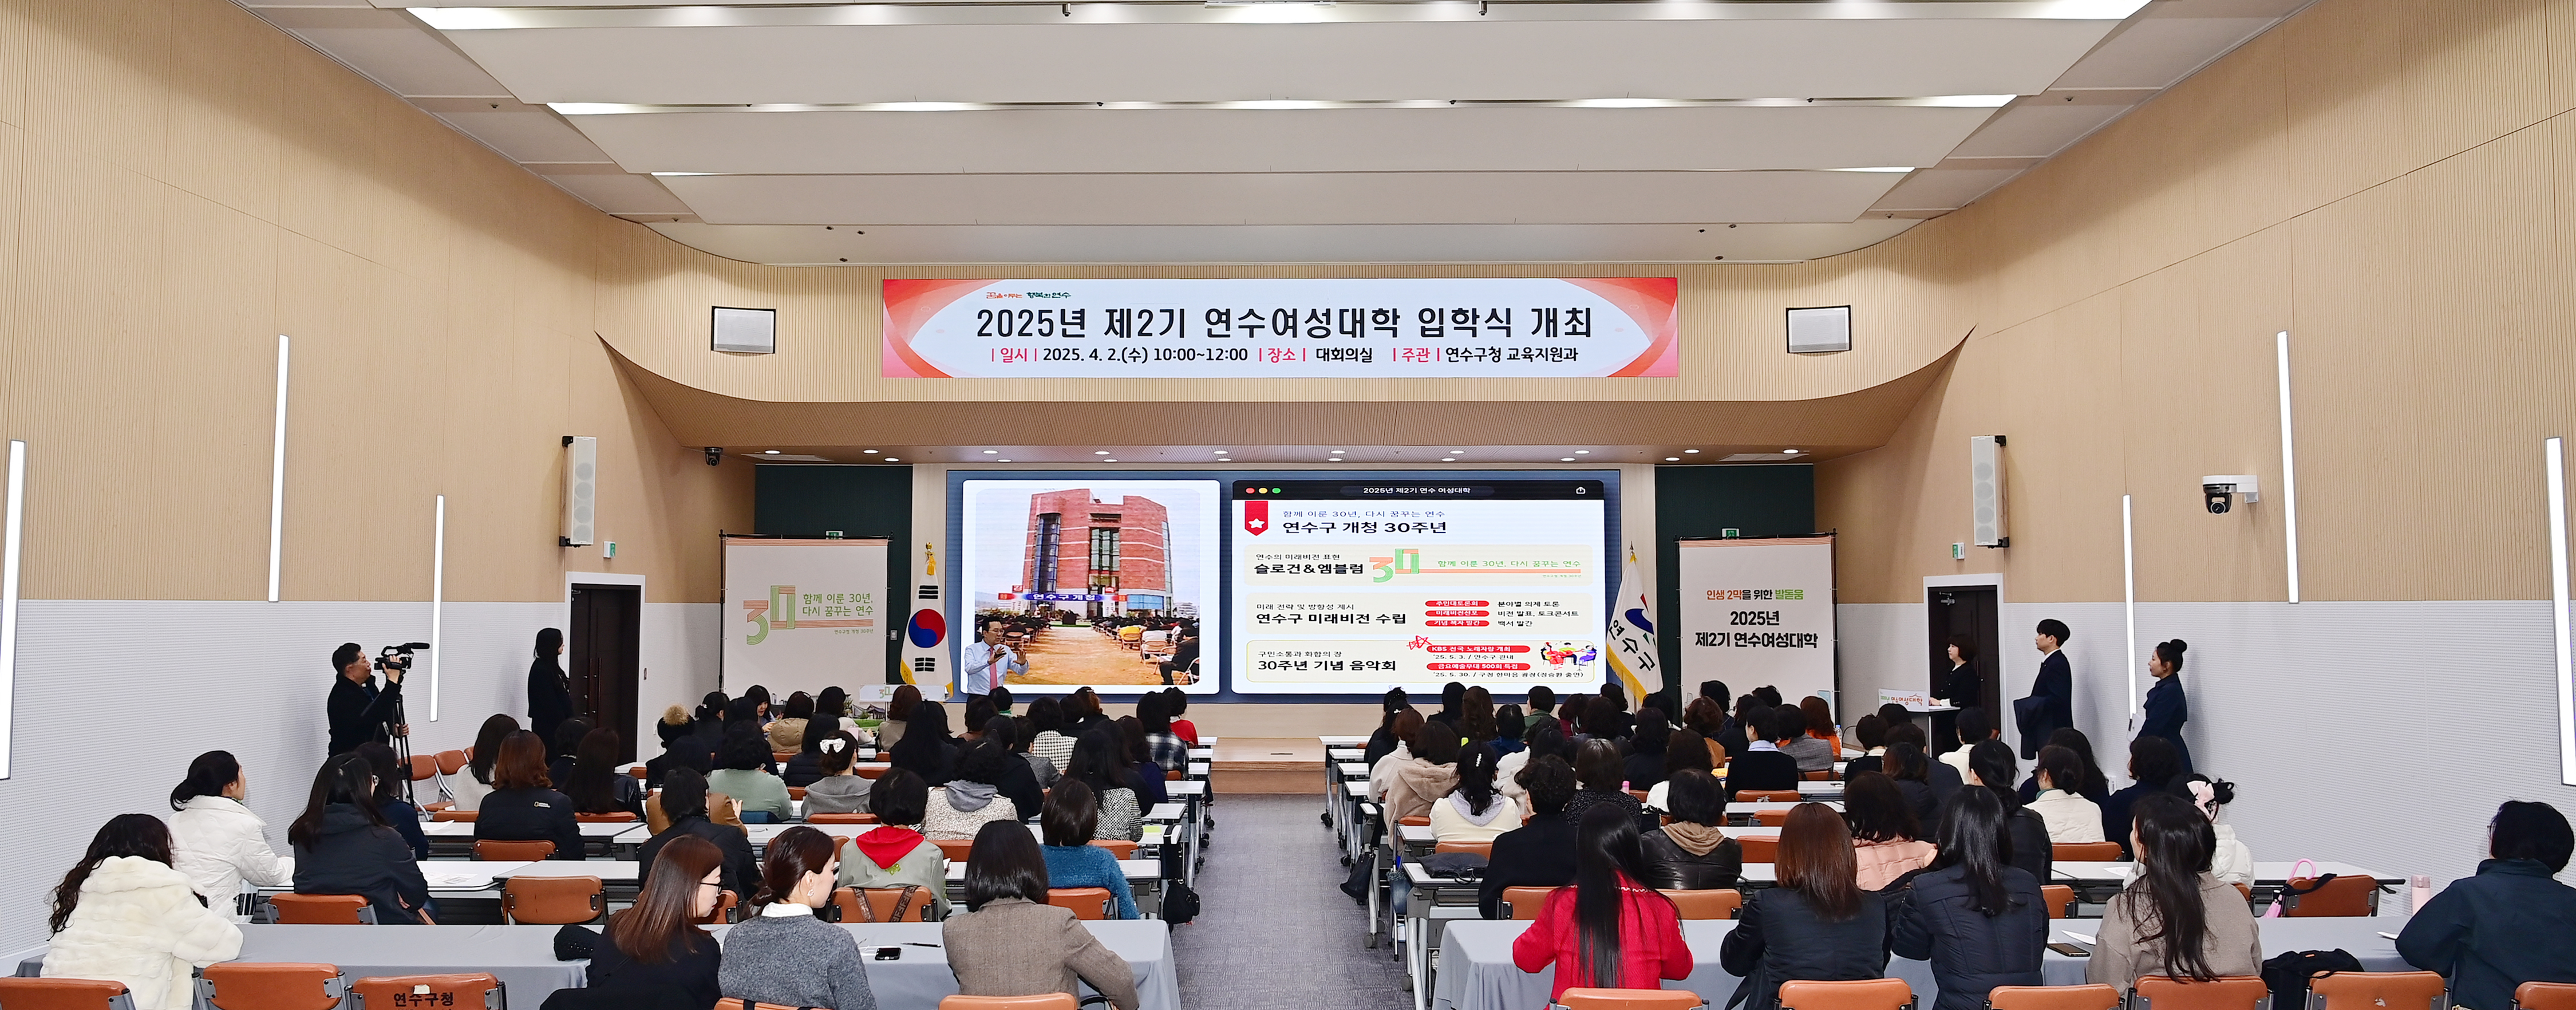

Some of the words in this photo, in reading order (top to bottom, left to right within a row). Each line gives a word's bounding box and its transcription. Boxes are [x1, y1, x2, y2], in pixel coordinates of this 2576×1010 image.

[977, 308, 1085, 338] 2025년
[1104, 308, 1185, 338] 제2기
[1205, 307, 1401, 339] 연수여성대학
[1418, 307, 1511, 338] 입학식
[1531, 307, 1591, 338] 개최
[1000, 348, 1028, 363] 일시
[1043, 348, 1084, 361] 2025.
[1089, 348, 1103, 361] 4.
[1107, 346, 1148, 364] 2.(수)
[1153, 348, 1248, 361] 10:00~12:00
[1267, 348, 1296, 364] 장소
[1316, 347, 1372, 363] 대회의실
[1401, 348, 1431, 363] 주관
[1445, 346, 1502, 363] 연수구청
[1506, 346, 1579, 363] 교육지원과
[1283, 522, 1337, 534] 연수구
[1342, 522, 1377, 534] 개청
[1384, 522, 1446, 534] 30주년
[803, 593, 822, 605] 함께
[827, 593, 845, 605] 이룬
[848, 593, 873, 604] 30년,
[1706, 590, 1725, 600] 인생
[1726, 589, 1752, 600] 2막을
[1753, 589, 1773, 600] 위한
[1775, 589, 1804, 600] 발돋움
[802, 606, 820, 617] 다시
[824, 606, 852, 617] 꿈꾸는
[855, 605, 874, 617] 연수
[1256, 613, 1303, 624] 연수구
[1309, 613, 1370, 624] 미래비전
[1375, 613, 1406, 624] 수립
[1730, 610, 1780, 626] 2025년
[1609, 620, 1656, 672] 연수구
[1695, 632, 1730, 648] 제2기
[1734, 632, 1819, 649] 연수여성대학
[1258, 660, 1307, 671] 30주년
[1314, 660, 1344, 671] 기념
[1349, 660, 1396, 671] 음악회
[394, 992, 453, 1006] 연수구청
